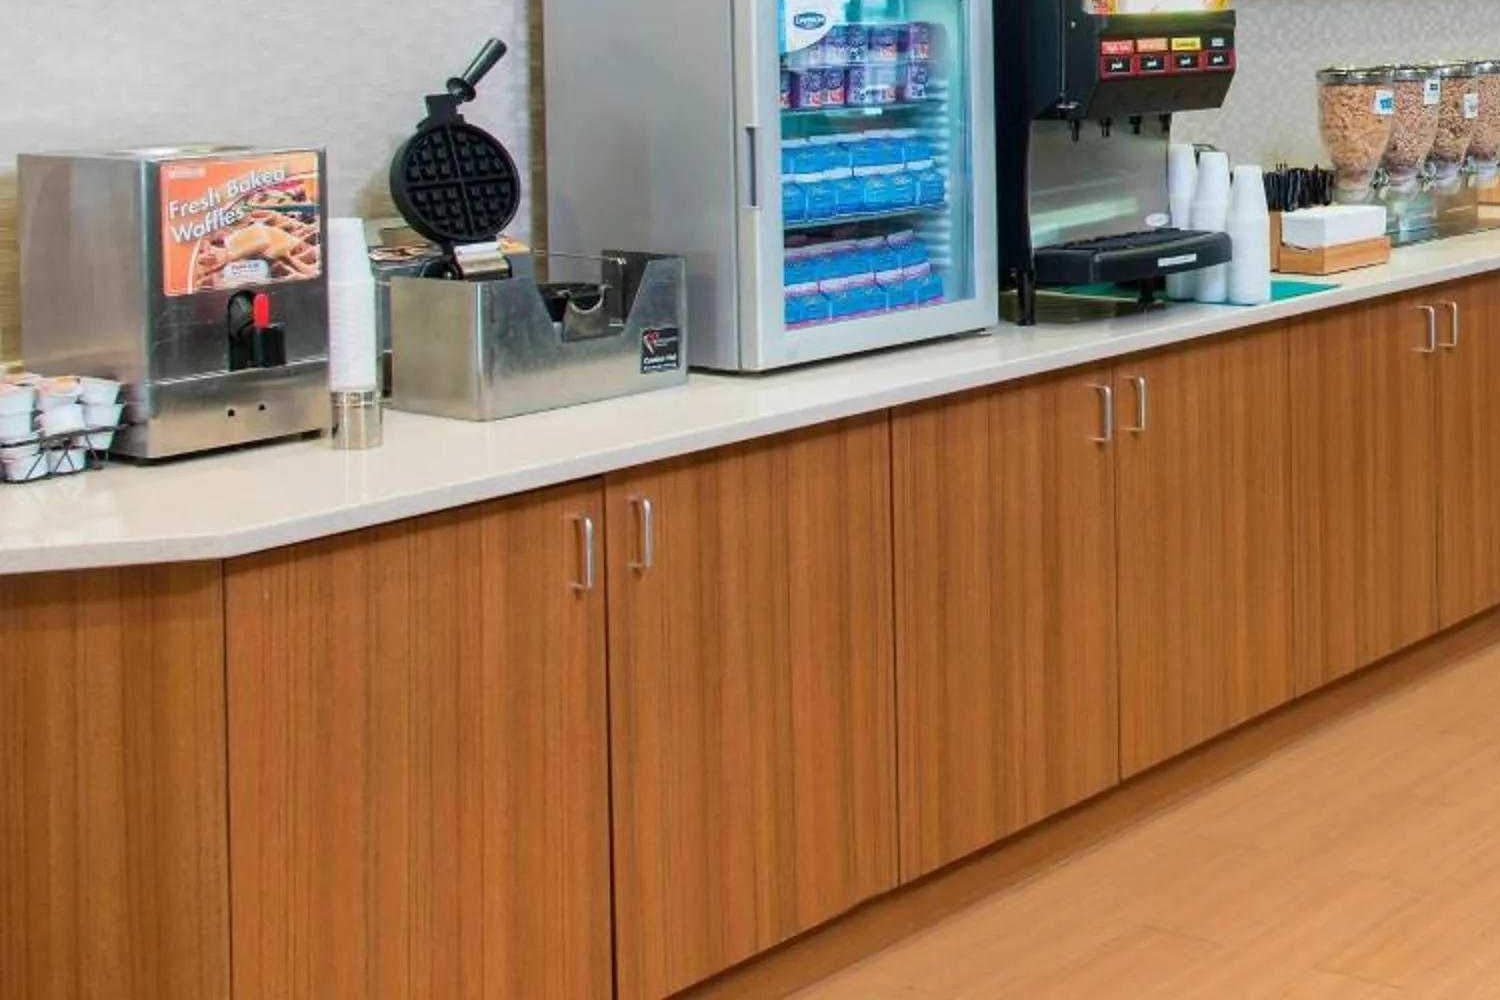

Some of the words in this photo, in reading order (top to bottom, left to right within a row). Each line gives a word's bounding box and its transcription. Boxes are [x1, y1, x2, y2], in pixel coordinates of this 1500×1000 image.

[169, 187, 221, 219] Fresh
[227, 169, 286, 197] Baked
[171, 205, 246, 243] Waffles
